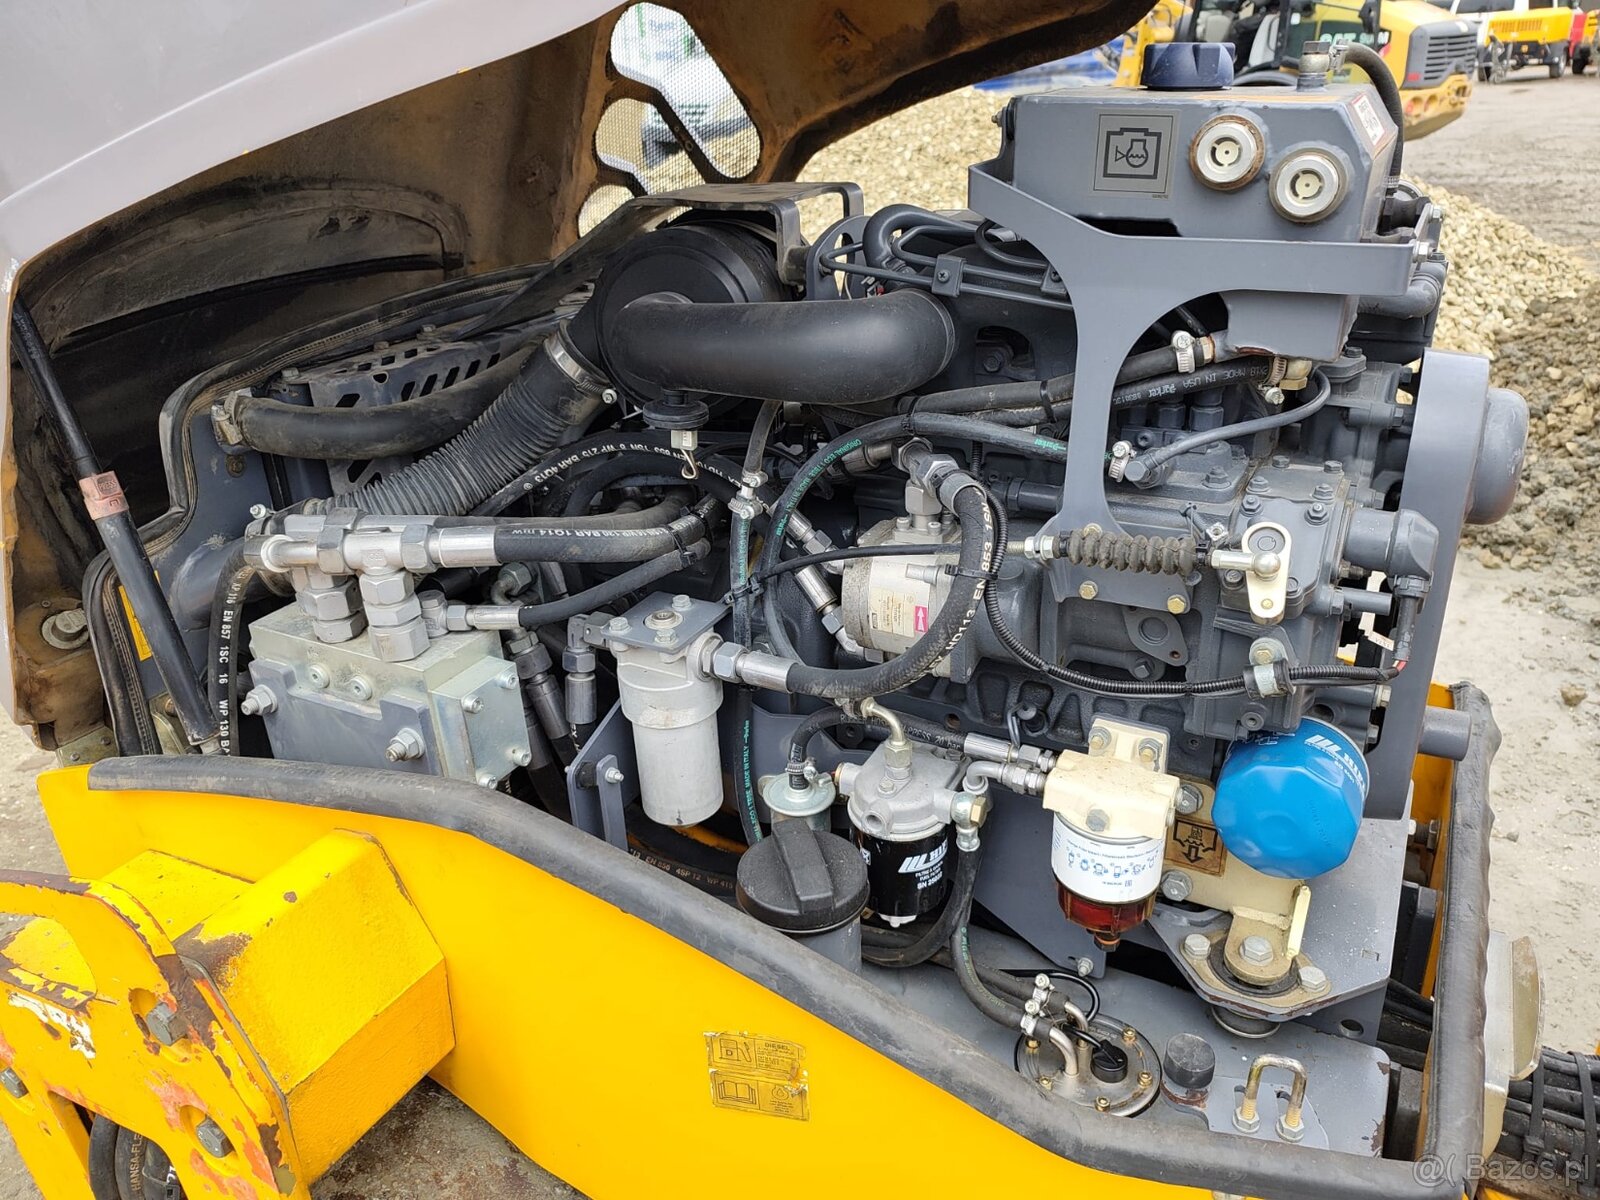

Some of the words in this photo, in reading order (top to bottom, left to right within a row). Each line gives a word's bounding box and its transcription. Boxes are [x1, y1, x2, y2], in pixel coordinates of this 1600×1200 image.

[1182, 377, 1201, 388] USA
[1205, 373, 1217, 384] IN
[1148, 384, 1177, 397] Parker
[601, 444, 617, 454] WP
[557, 454, 581, 472] BAR
[981, 502, 994, 531] 1SN
[981, 542, 994, 573] 853
[973, 577, 988, 601] EN
[222, 610, 234, 623] EN
[221, 624, 231, 641] 857
[219, 645, 230, 664] 1SC
[218, 673, 229, 685] 16
[218, 700, 230, 717] WP
[219, 720, 231, 738] 130
[220, 740, 231, 757] BA
